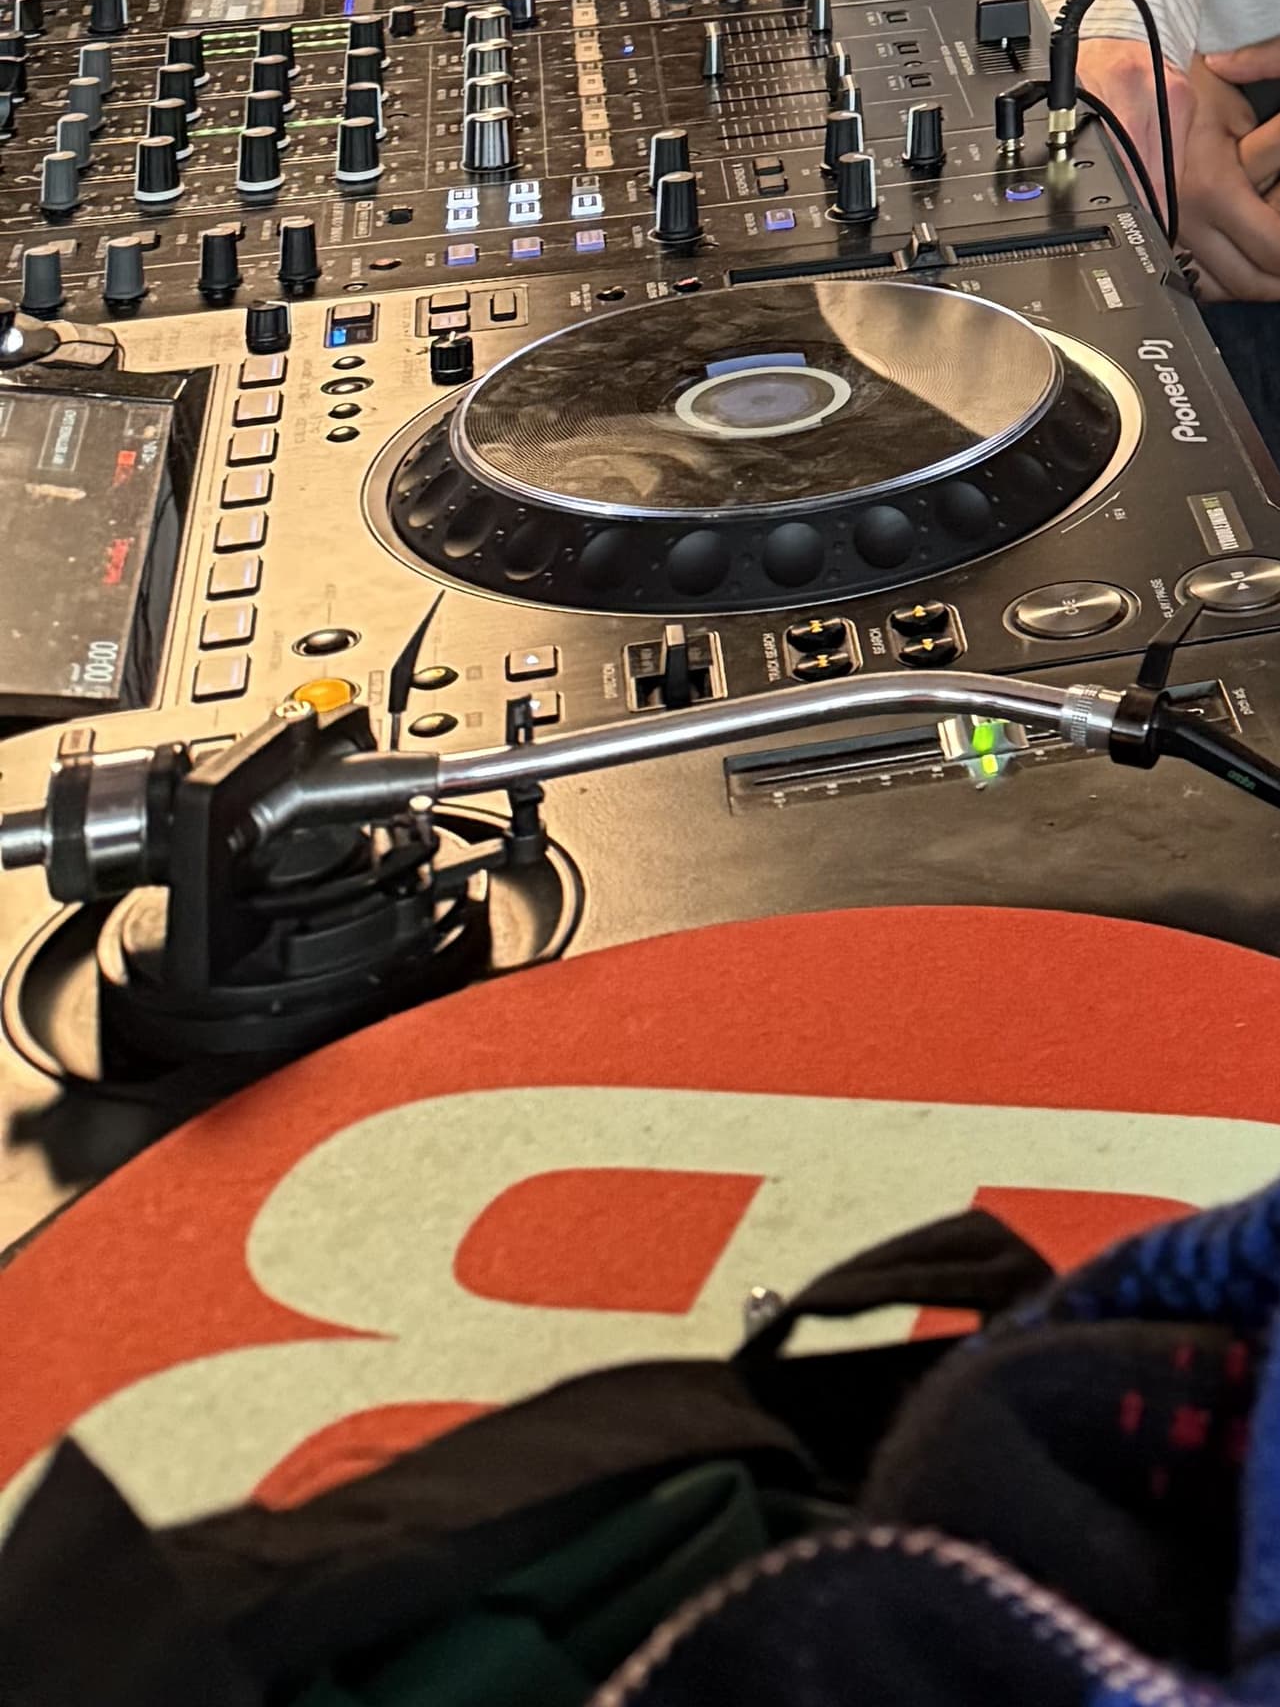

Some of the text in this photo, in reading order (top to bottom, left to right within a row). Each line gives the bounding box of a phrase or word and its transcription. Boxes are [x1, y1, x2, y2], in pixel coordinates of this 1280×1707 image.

[1153, 364, 1207, 443] Pioneer
[762, 632, 779, 659] SEARCH
[869, 627, 885, 655] SEARCH
